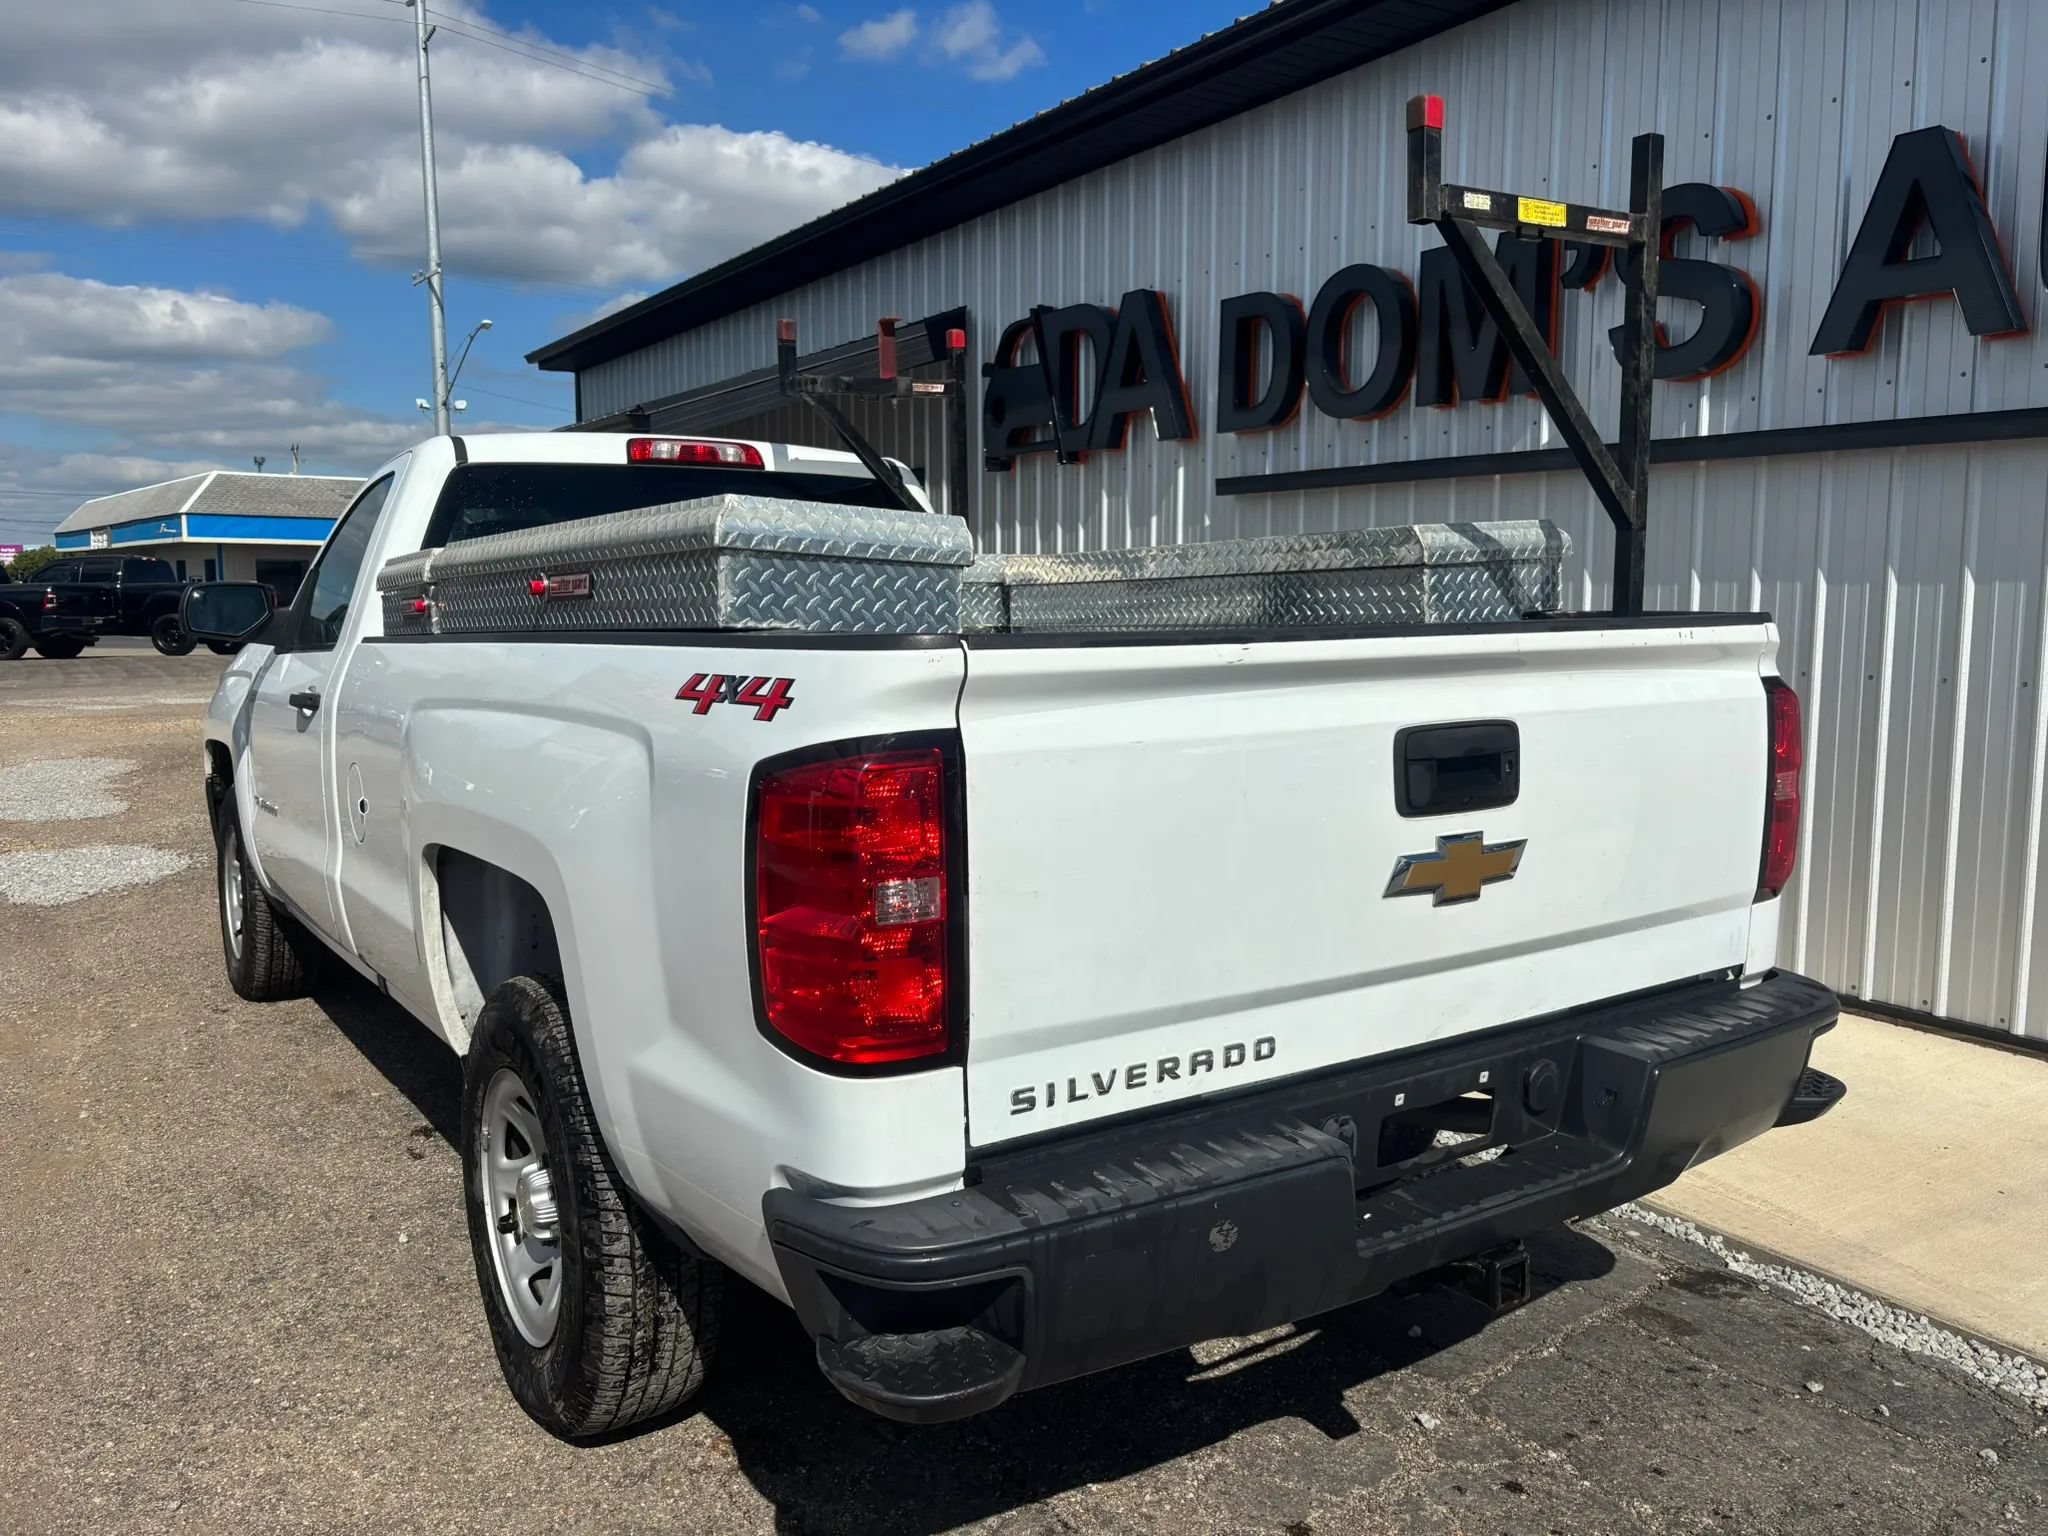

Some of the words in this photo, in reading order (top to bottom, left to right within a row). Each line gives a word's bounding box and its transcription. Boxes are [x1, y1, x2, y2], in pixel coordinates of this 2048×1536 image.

[1217, 182, 1760, 434] DOM'S
[1808, 124, 2048, 361] A
[1009, 1035, 1276, 1116] SILVERADO
